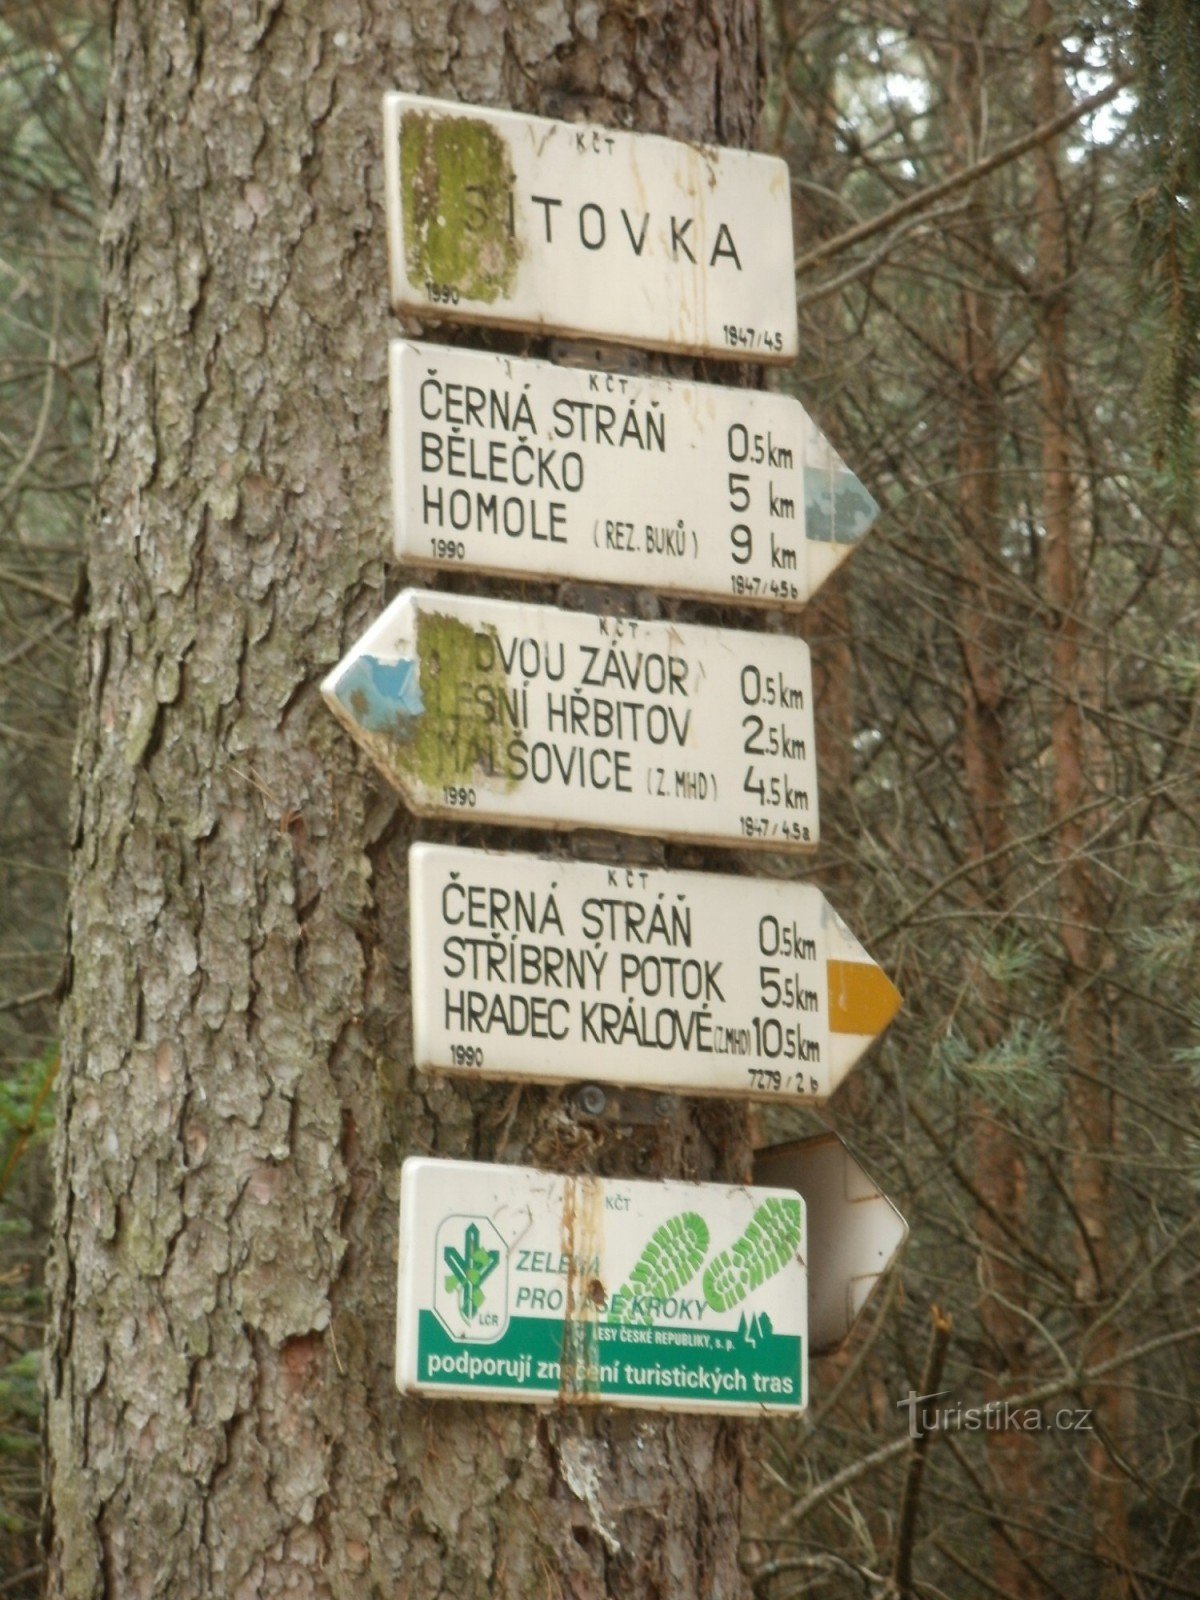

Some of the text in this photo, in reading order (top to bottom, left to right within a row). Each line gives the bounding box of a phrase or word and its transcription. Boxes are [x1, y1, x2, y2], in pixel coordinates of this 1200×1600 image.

[426, 281, 460, 304] 1990
[723, 324, 783, 353] 1847/45
[589, 373, 629, 394] KČT
[420, 368, 538, 436] ČERNÁ
[553, 398, 667, 453] STRÁŇ
[421, 426, 795, 520] BĚLEČKO 5 km
[423, 484, 569, 544] HOMOLE
[730, 523, 753, 565] 9
[770, 532, 798, 570] km
[431, 537, 465, 560] 1990
[475, 632, 565, 682] DVOU
[579, 640, 689, 697] ZÁVOR
[547, 688, 692, 747] HŘBITOV
[443, 786, 476, 808] 1990
[442, 870, 565, 937] ČERNÁ
[581, 891, 693, 949] STRÁŇ
[443, 931, 608, 992] STŘÍBRNÝ
[620, 952, 727, 1003] POTOK
[444, 988, 570, 1041] HRADEC
[580, 995, 714, 1054] KRÁLOVÉ
[450, 1045, 483, 1068] 1990
[605, 1193, 632, 1212] KČT
[515, 1286, 563, 1311] PRO
[631, 1296, 708, 1321] KROKY
[619, 1325, 653, 1345] ČESKÉ
[427, 1351, 531, 1383] podporují
[624, 1362, 747, 1394] turistických
[752, 1373, 794, 1394] tras
